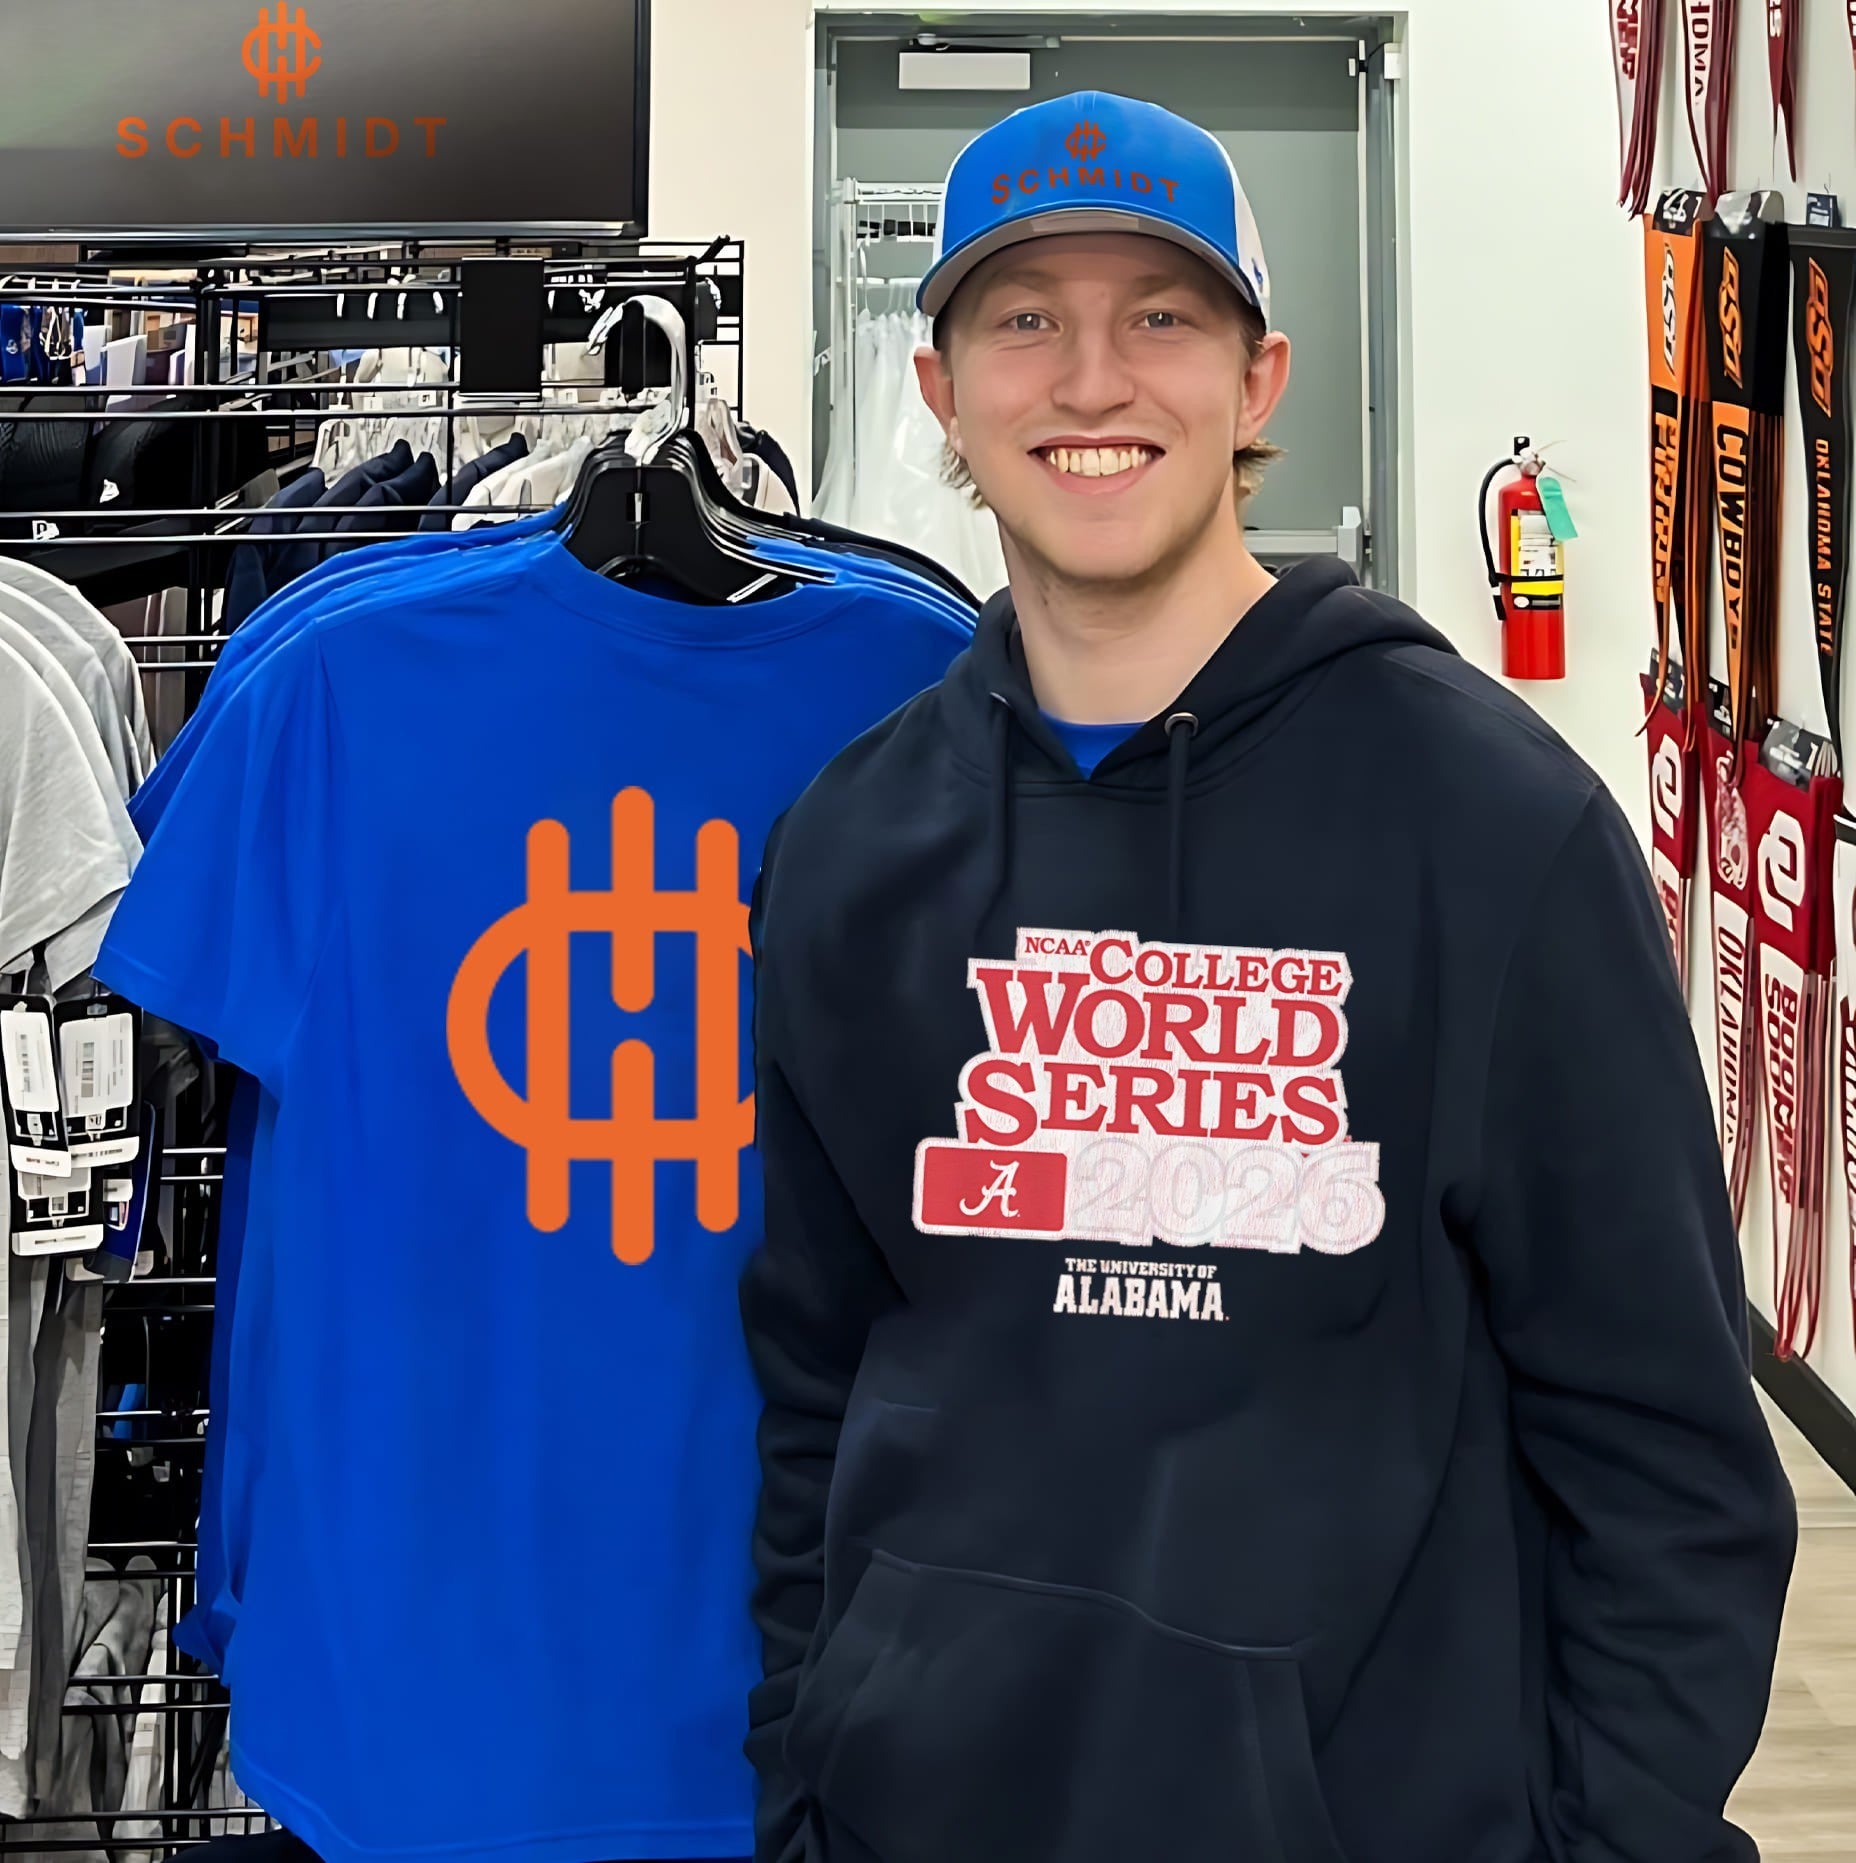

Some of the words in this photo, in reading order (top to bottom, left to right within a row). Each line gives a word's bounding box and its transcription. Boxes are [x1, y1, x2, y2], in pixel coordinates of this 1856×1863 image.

[116, 117, 447, 158] SCHMIDT
[992, 167, 1179, 205] SCHMIDT
[1815, 438, 1832, 570] OKLAHOMA
[1089, 938, 1343, 996] COLLEGE
[976, 968, 1340, 1067] WORLD
[964, 1058, 1341, 1147] SERIES
[1071, 1138, 1382, 1252] 2026
[1065, 1258, 1097, 1274] THE
[1099, 1260, 1196, 1278] UNIVERSITY
[1197, 1265, 1217, 1279] OF
[1053, 1275, 1224, 1321] ALABAMA
